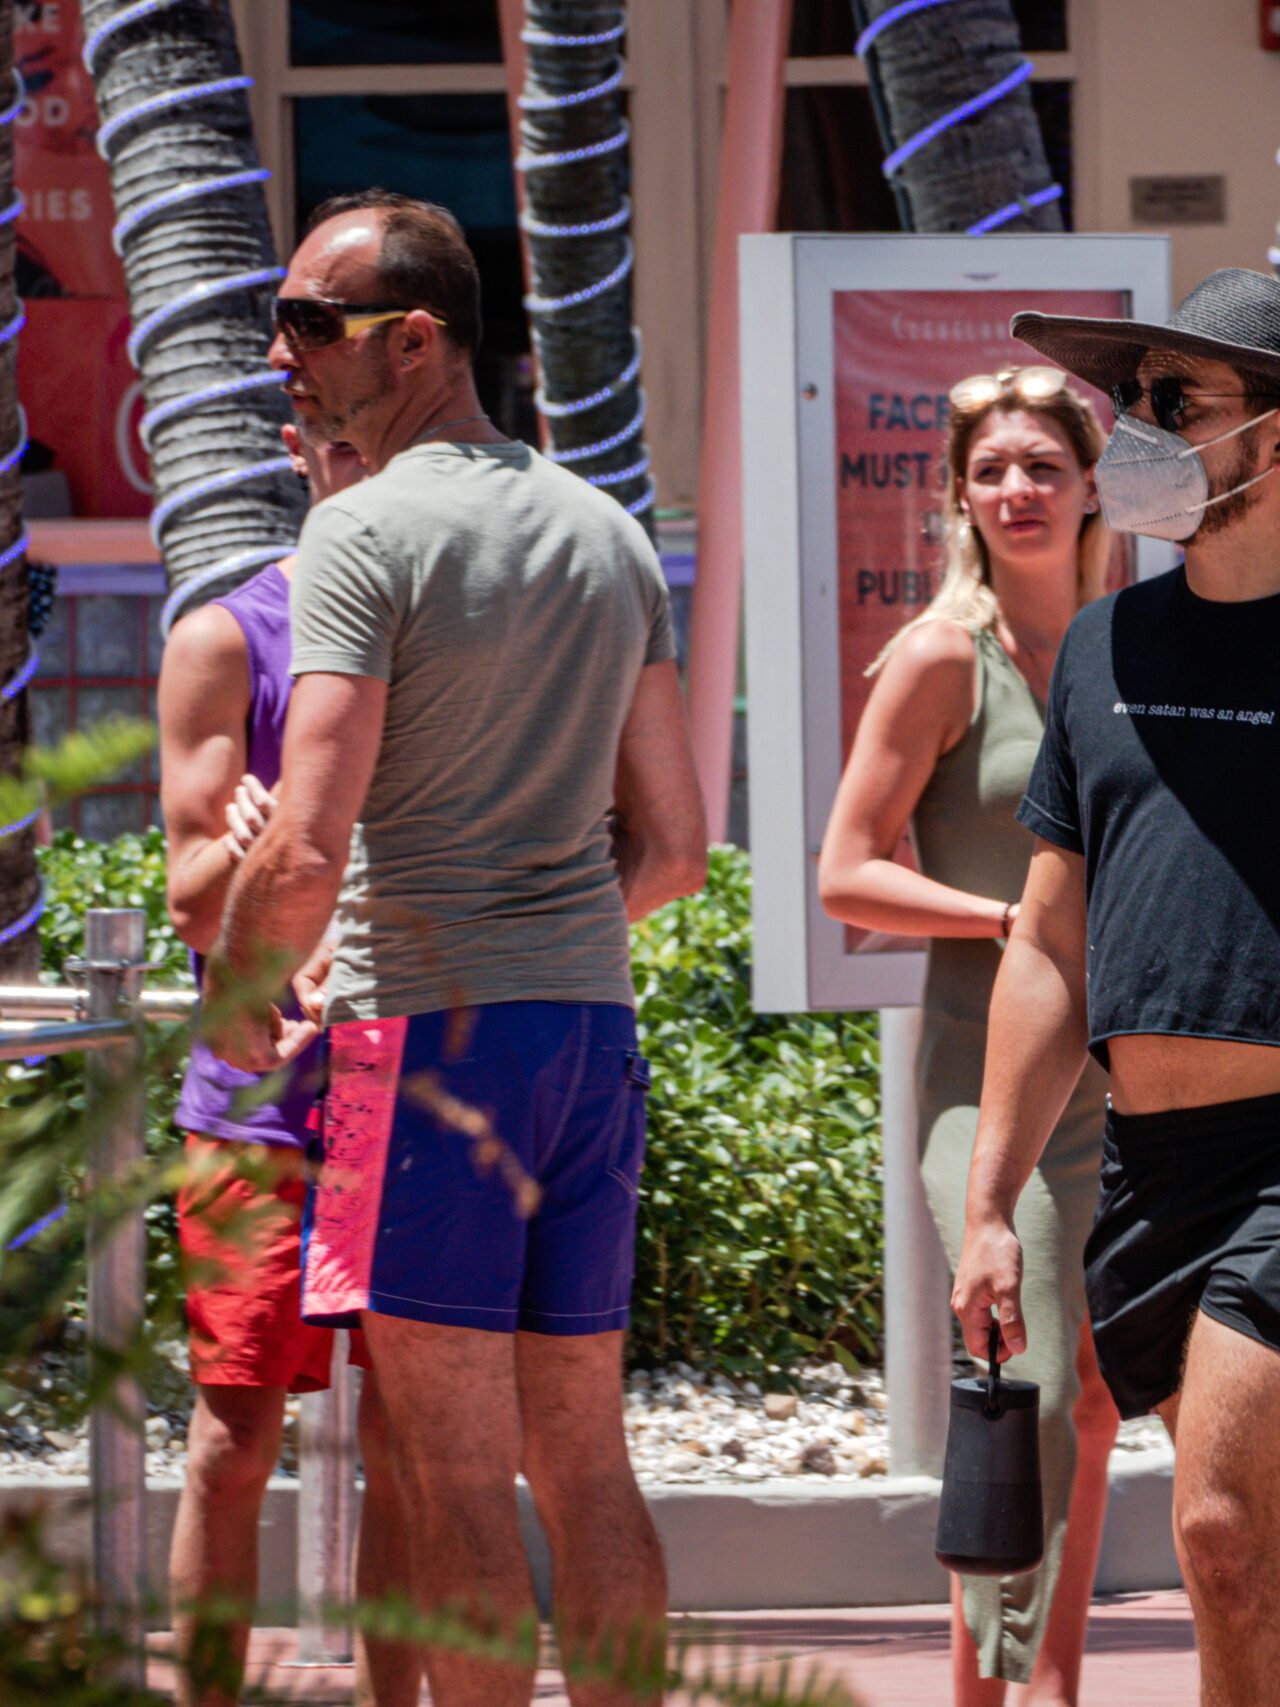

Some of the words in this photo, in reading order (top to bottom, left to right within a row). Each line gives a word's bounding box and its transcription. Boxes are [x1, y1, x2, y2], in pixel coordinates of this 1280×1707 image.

[15, 4, 61, 32] KE
[15, 96, 70, 127] OD
[840, 452, 929, 489] MUST
[857, 567, 946, 606] PUBL
[1113, 702, 1146, 715] even
[1148, 703, 1185, 717] satan
[1189, 706, 1214, 719] was
[1216, 709, 1234, 721] an
[1236, 711, 1276, 725] angel
